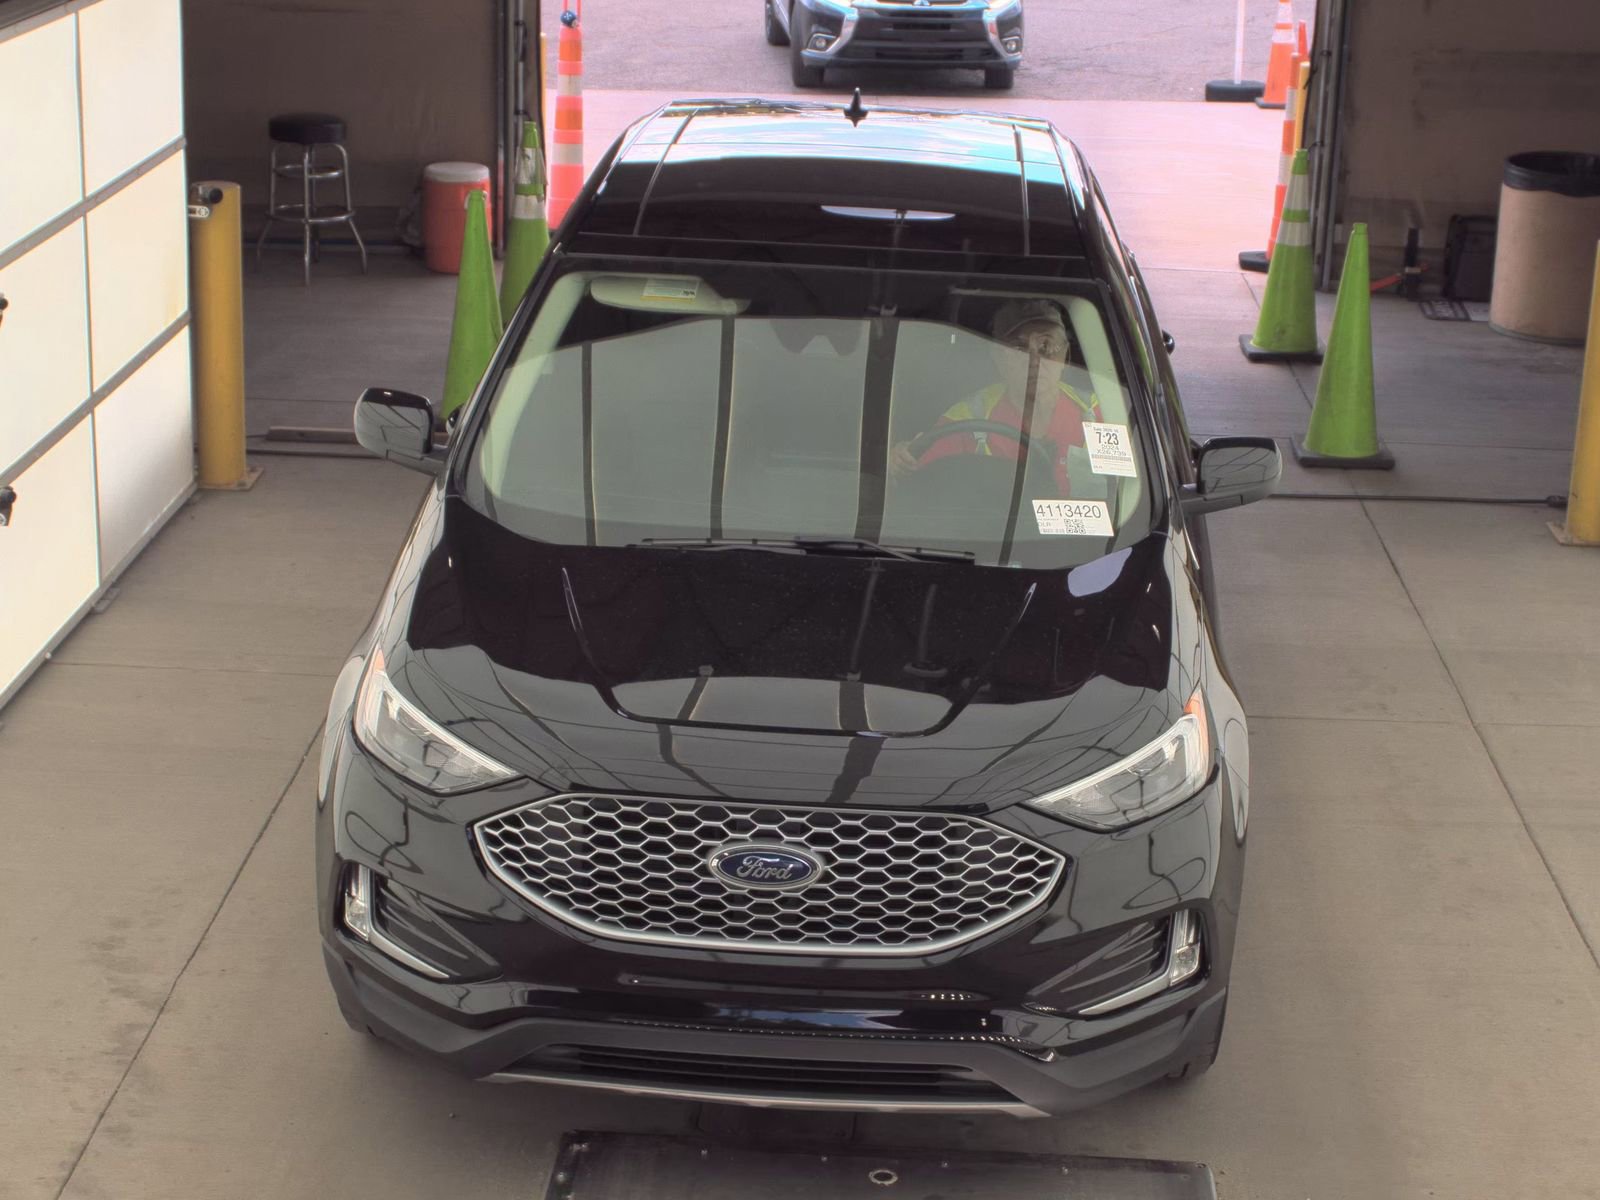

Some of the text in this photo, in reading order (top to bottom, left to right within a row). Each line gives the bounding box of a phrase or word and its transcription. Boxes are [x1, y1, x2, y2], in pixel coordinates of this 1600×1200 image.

[1096, 431, 1119, 445] 7:23
[1036, 504, 1101, 518] 4113420
[736, 855, 794, 880] Ford
